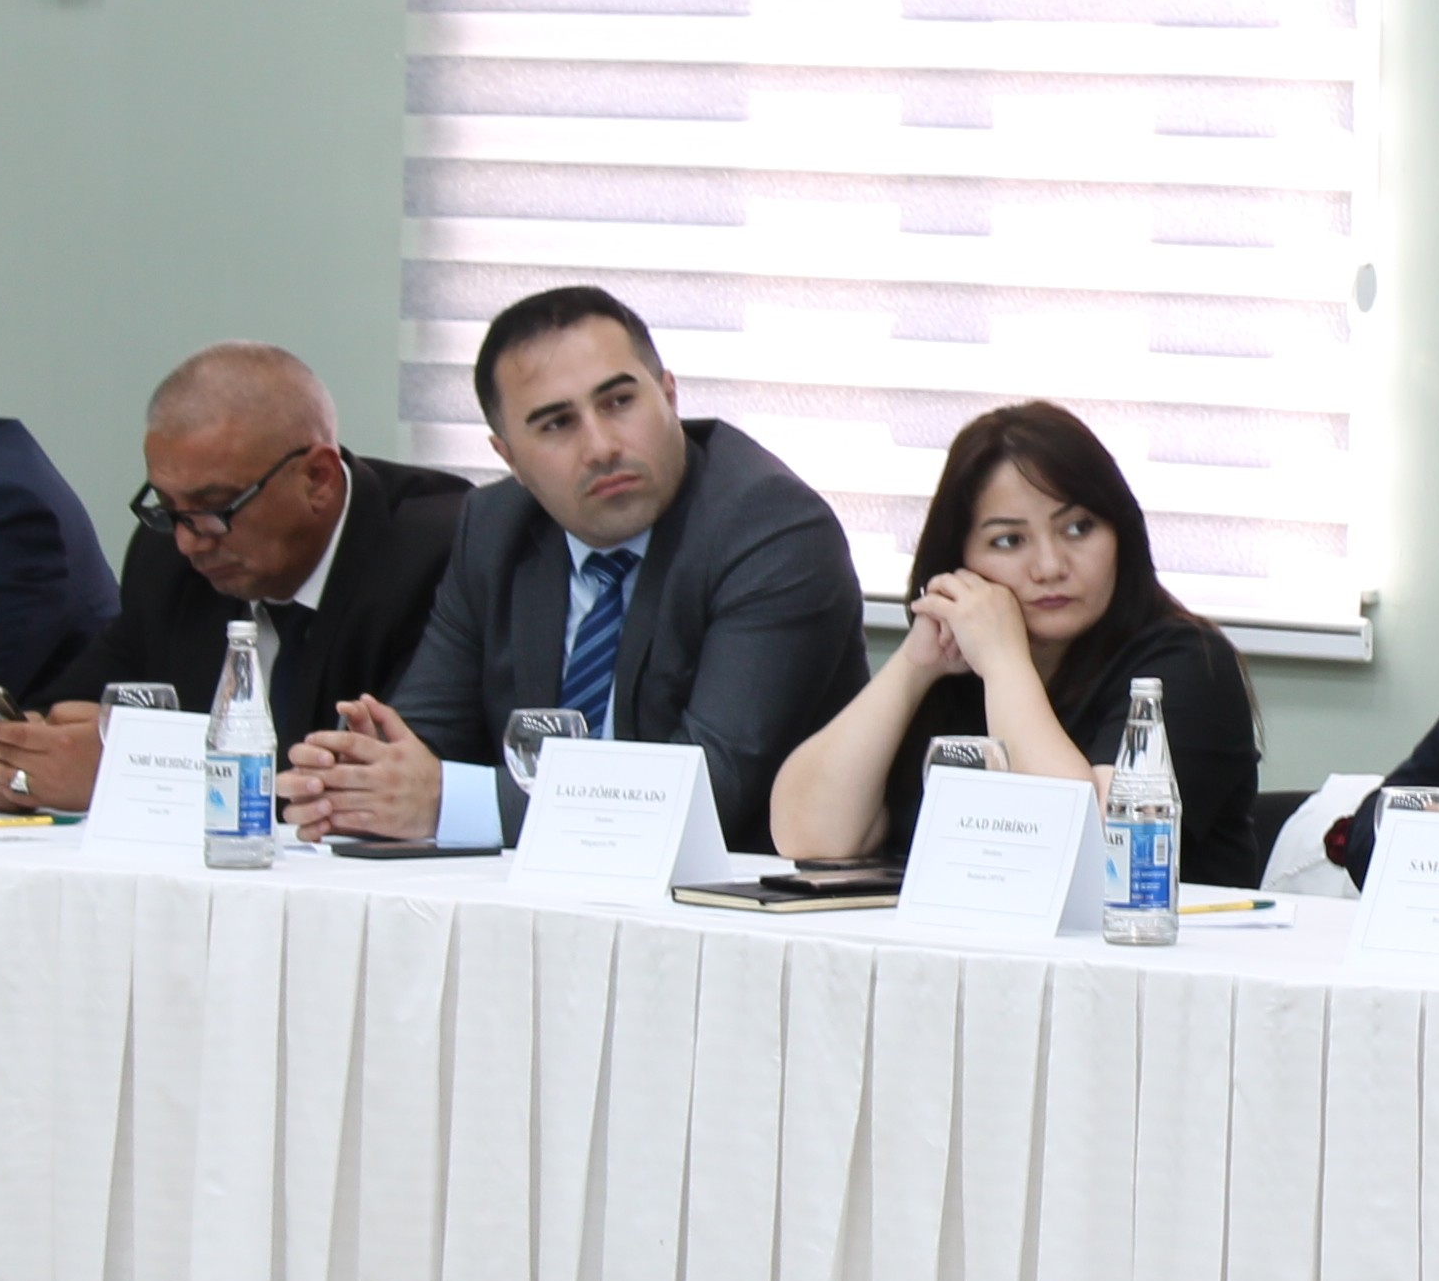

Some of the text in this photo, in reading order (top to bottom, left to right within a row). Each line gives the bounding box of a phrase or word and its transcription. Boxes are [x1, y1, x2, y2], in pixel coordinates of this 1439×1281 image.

[555, 784, 666, 802] LALƏ ZÖHRABZADƏ
[957, 815, 1042, 835] AZAD DİBİROV
